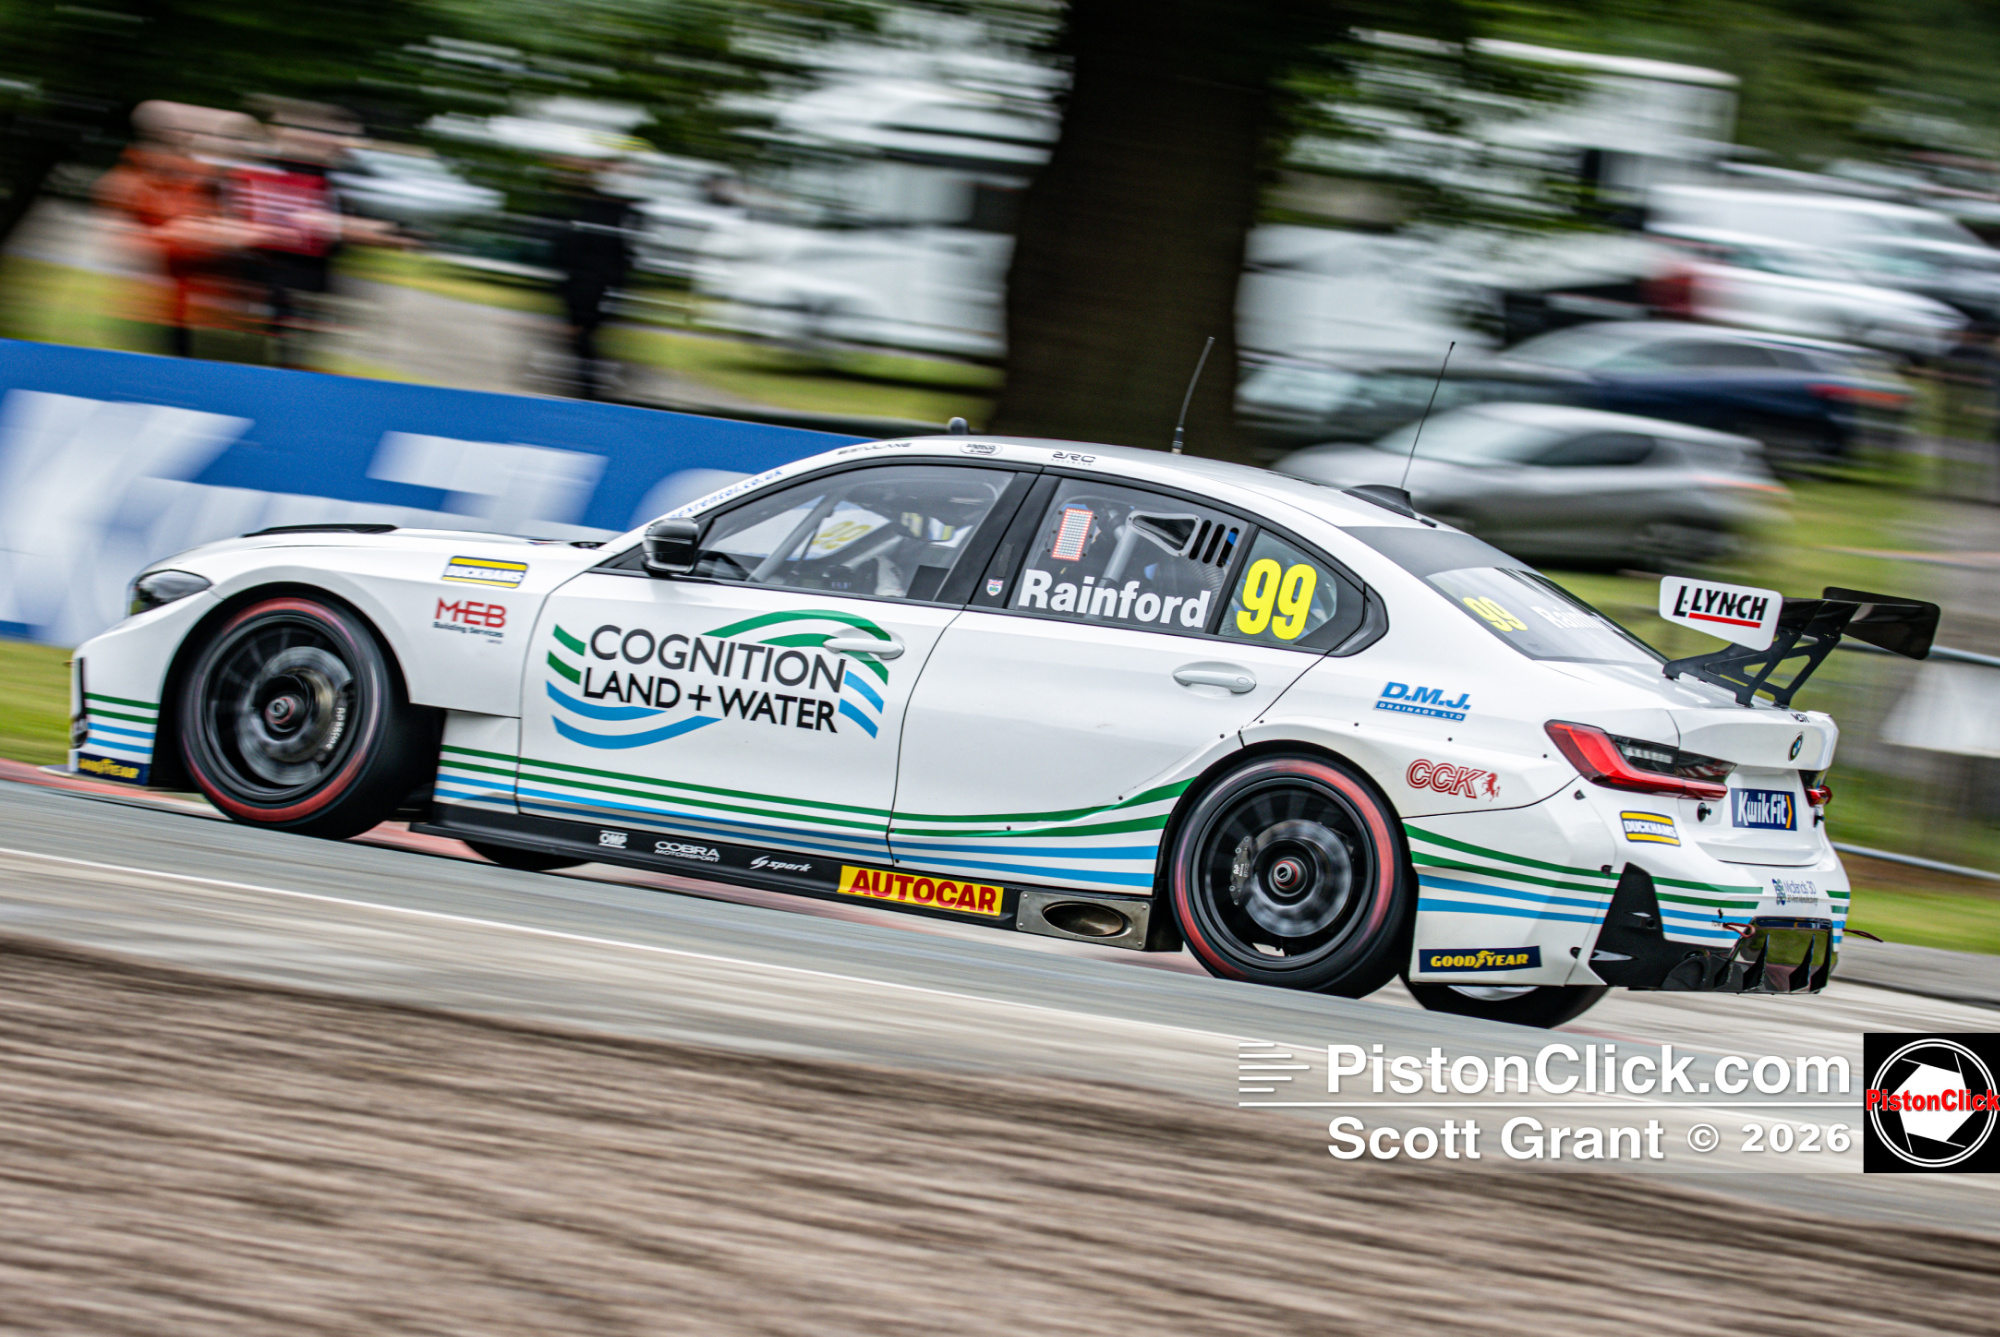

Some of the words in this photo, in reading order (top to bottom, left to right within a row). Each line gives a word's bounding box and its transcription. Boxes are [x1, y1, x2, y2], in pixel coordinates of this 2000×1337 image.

[434, 597, 507, 629] MEB
[1018, 568, 1212, 629] Rainford
[1236, 558, 1318, 641] 99
[433, 621, 468, 634] Building
[469, 625, 504, 638] Services
[1462, 596, 1528, 633] 99
[590, 624, 847, 693] COGNITION
[583, 666, 681, 709] LAND
[718, 685, 838, 734] WATER
[1380, 681, 1472, 711] D.M.J.
[1378, 702, 1437, 716] DRAINAGE
[1441, 711, 1463, 721] LTD
[1406, 758, 1488, 799] CCK
[598, 832, 628, 846] OMP
[1623, 818, 1679, 839] DUCKHAMS
[654, 840, 721, 858] COBRA
[654, 848, 720, 863] MOTORSPORT
[766, 860, 812, 873] spark
[848, 868, 997, 914] AUTOCAR
[1430, 950, 1530, 969] GOODYEAR
